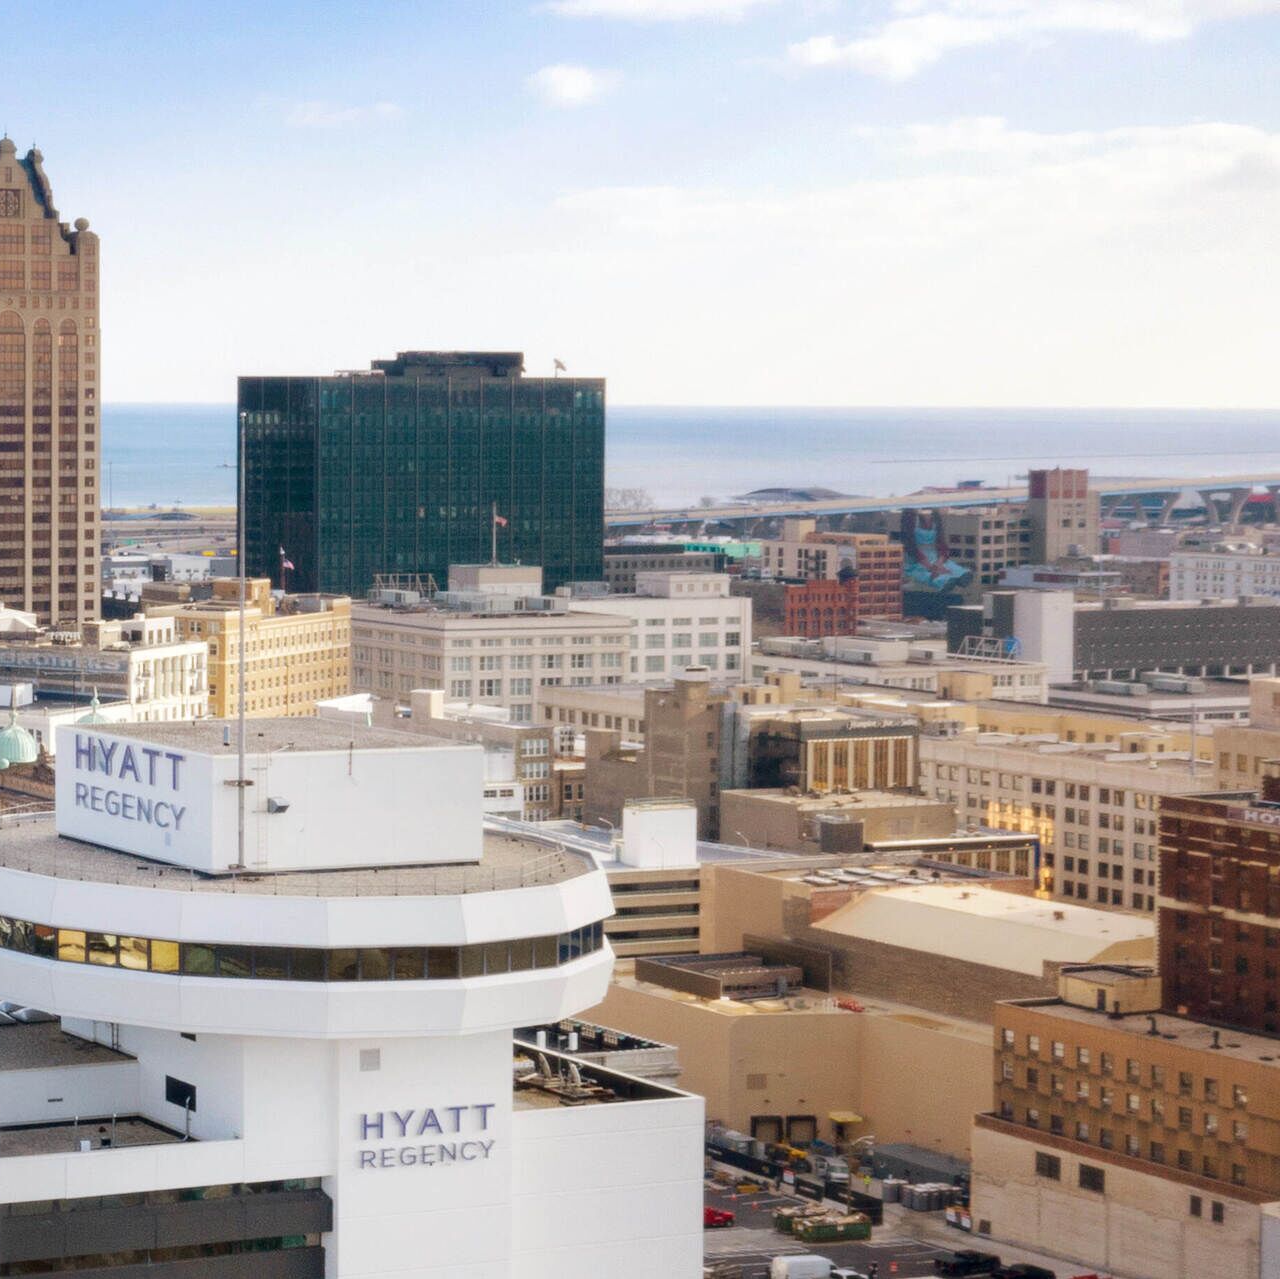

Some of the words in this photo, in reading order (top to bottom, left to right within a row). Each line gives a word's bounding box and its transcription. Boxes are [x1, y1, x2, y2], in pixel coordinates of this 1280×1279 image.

[75, 734, 185, 791] HYATT
[75, 782, 186, 830] REGENCY
[360, 1103, 496, 1140] HYATT
[359, 1140, 496, 1169] REGENCY
